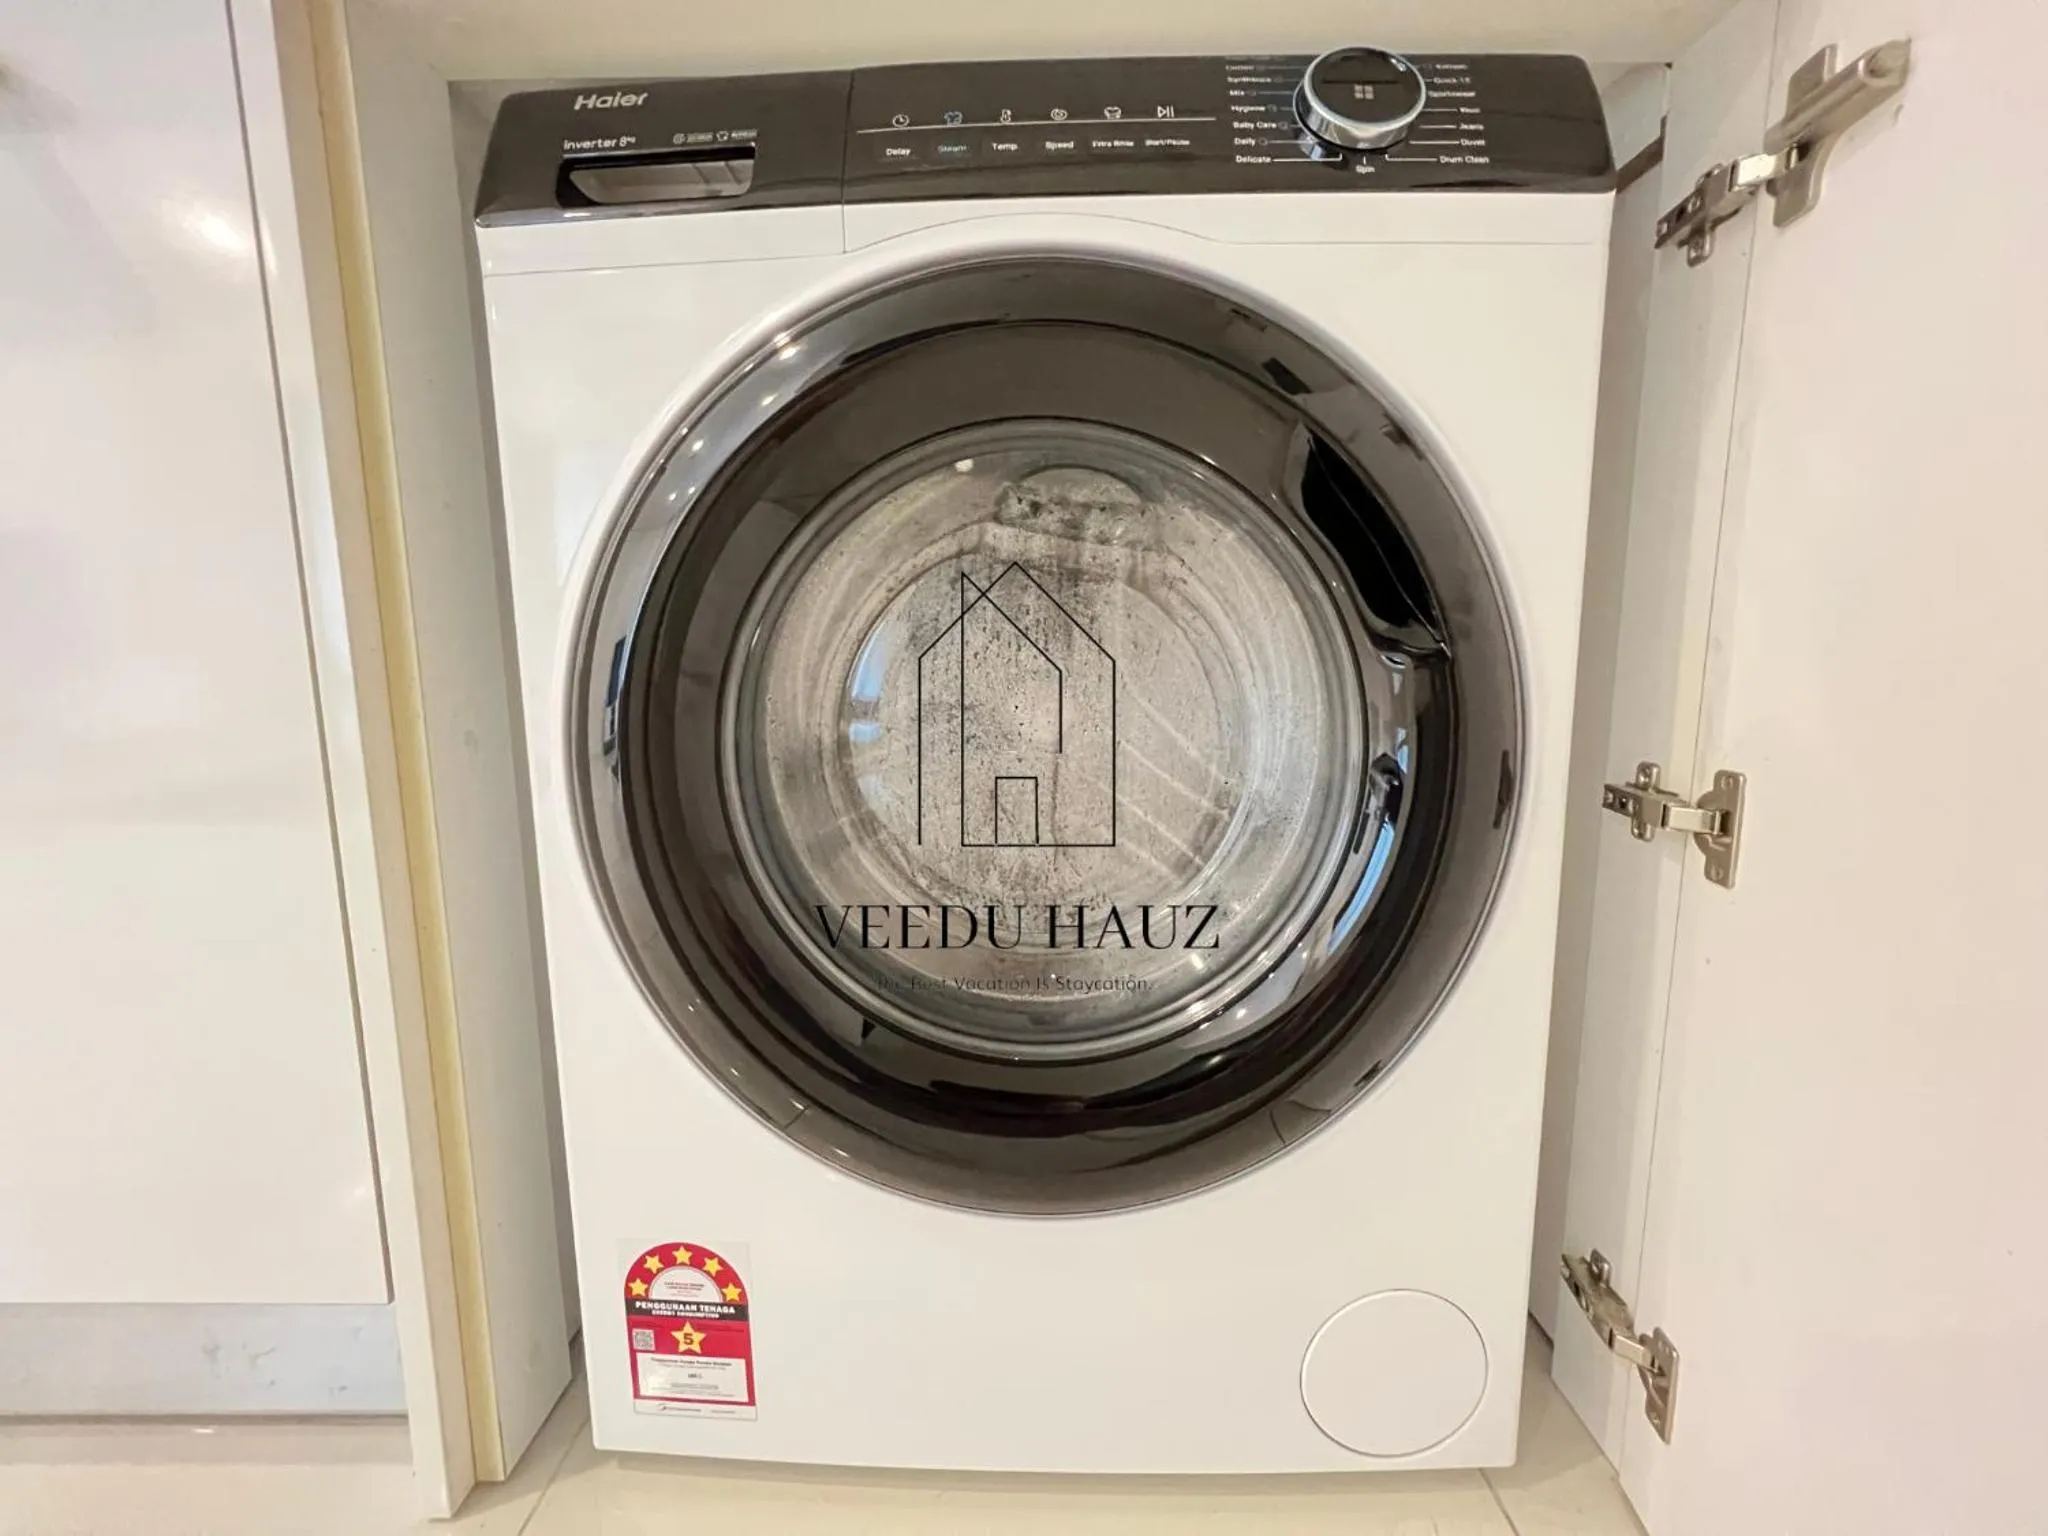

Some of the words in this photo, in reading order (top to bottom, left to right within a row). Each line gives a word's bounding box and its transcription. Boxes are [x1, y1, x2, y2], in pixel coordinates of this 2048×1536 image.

[574, 91, 648, 111] Haier
[1233, 121, 1255, 130] Baby
[1256, 121, 1277, 129] Care
[563, 137, 617, 150] inverter
[1045, 141, 1074, 151] Speed
[1234, 137, 1256, 147] Daily
[1460, 138, 1486, 146] Duvet
[885, 147, 911, 157] Delay
[1235, 154, 1272, 163] Delicate
[1439, 155, 1463, 164] Drum
[1465, 155, 1490, 164] Clean
[1355, 165, 1376, 174] Spin
[635, 1301, 697, 1312] PENGGUNAAN
[699, 1303, 736, 1314] TENAGA
[683, 1333, 694, 1345] 5
